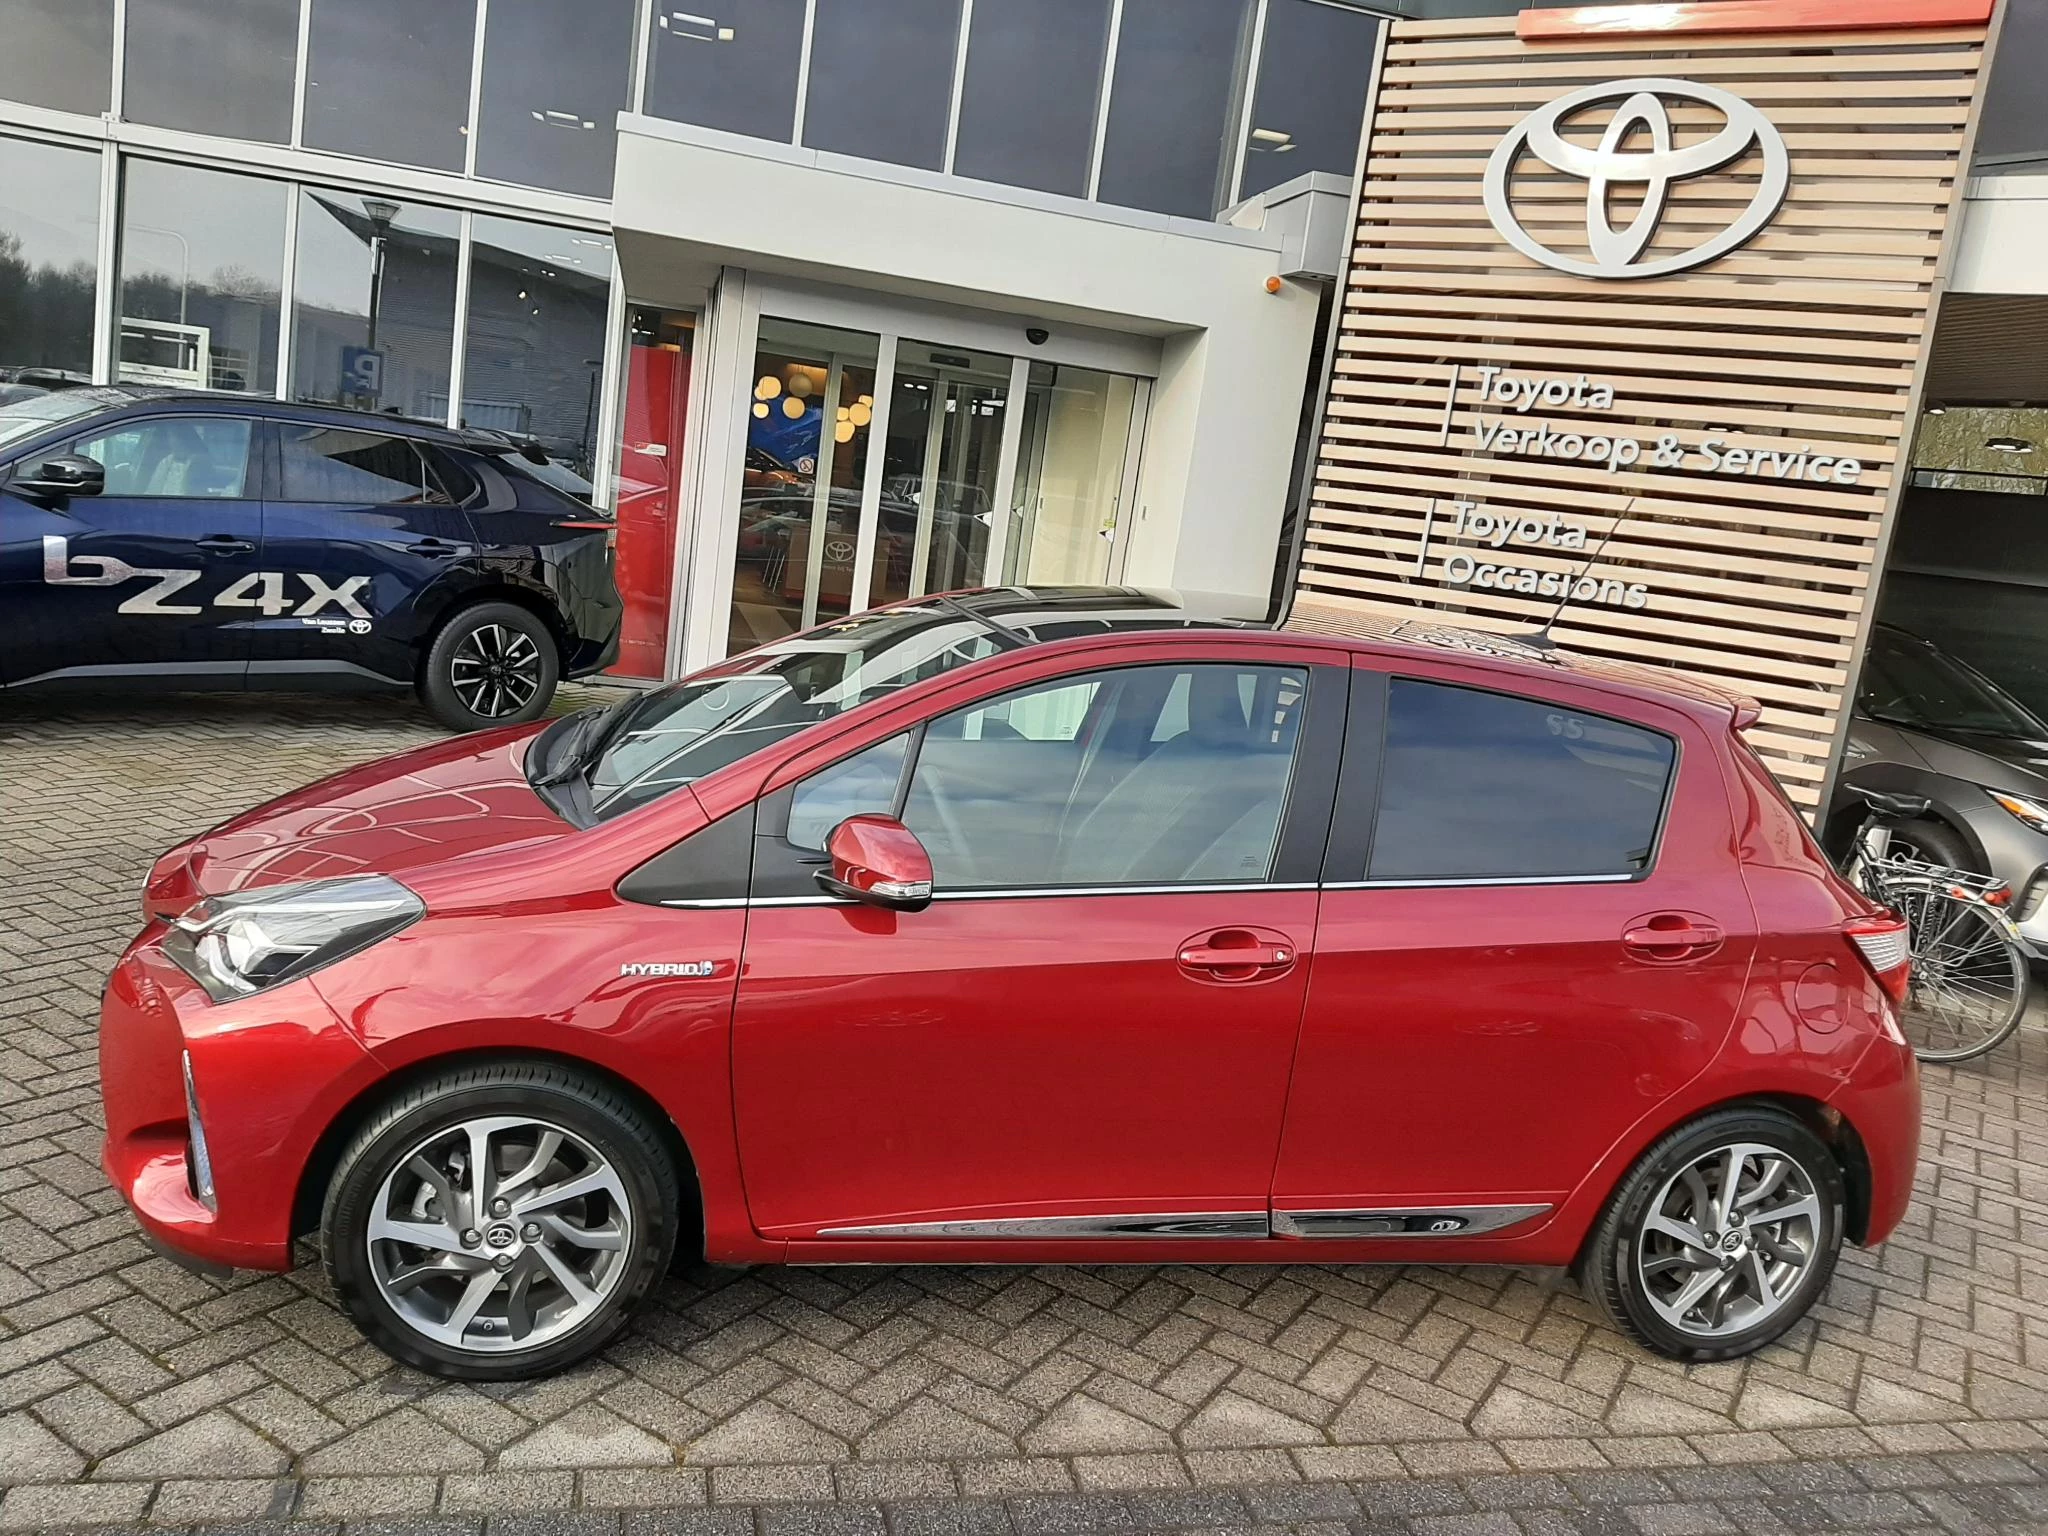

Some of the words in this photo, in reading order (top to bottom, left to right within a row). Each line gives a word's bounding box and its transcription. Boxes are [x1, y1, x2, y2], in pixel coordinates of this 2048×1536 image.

[1477, 366, 1615, 412] Toyota
[1474, 418, 1640, 473] Verkoop
[1652, 433, 1686, 469] &
[1699, 437, 1862, 485] Service
[1452, 501, 1588, 550] Toyota
[1443, 553, 1649, 610] Occasions
[620, 962, 703, 976] HYBRID
